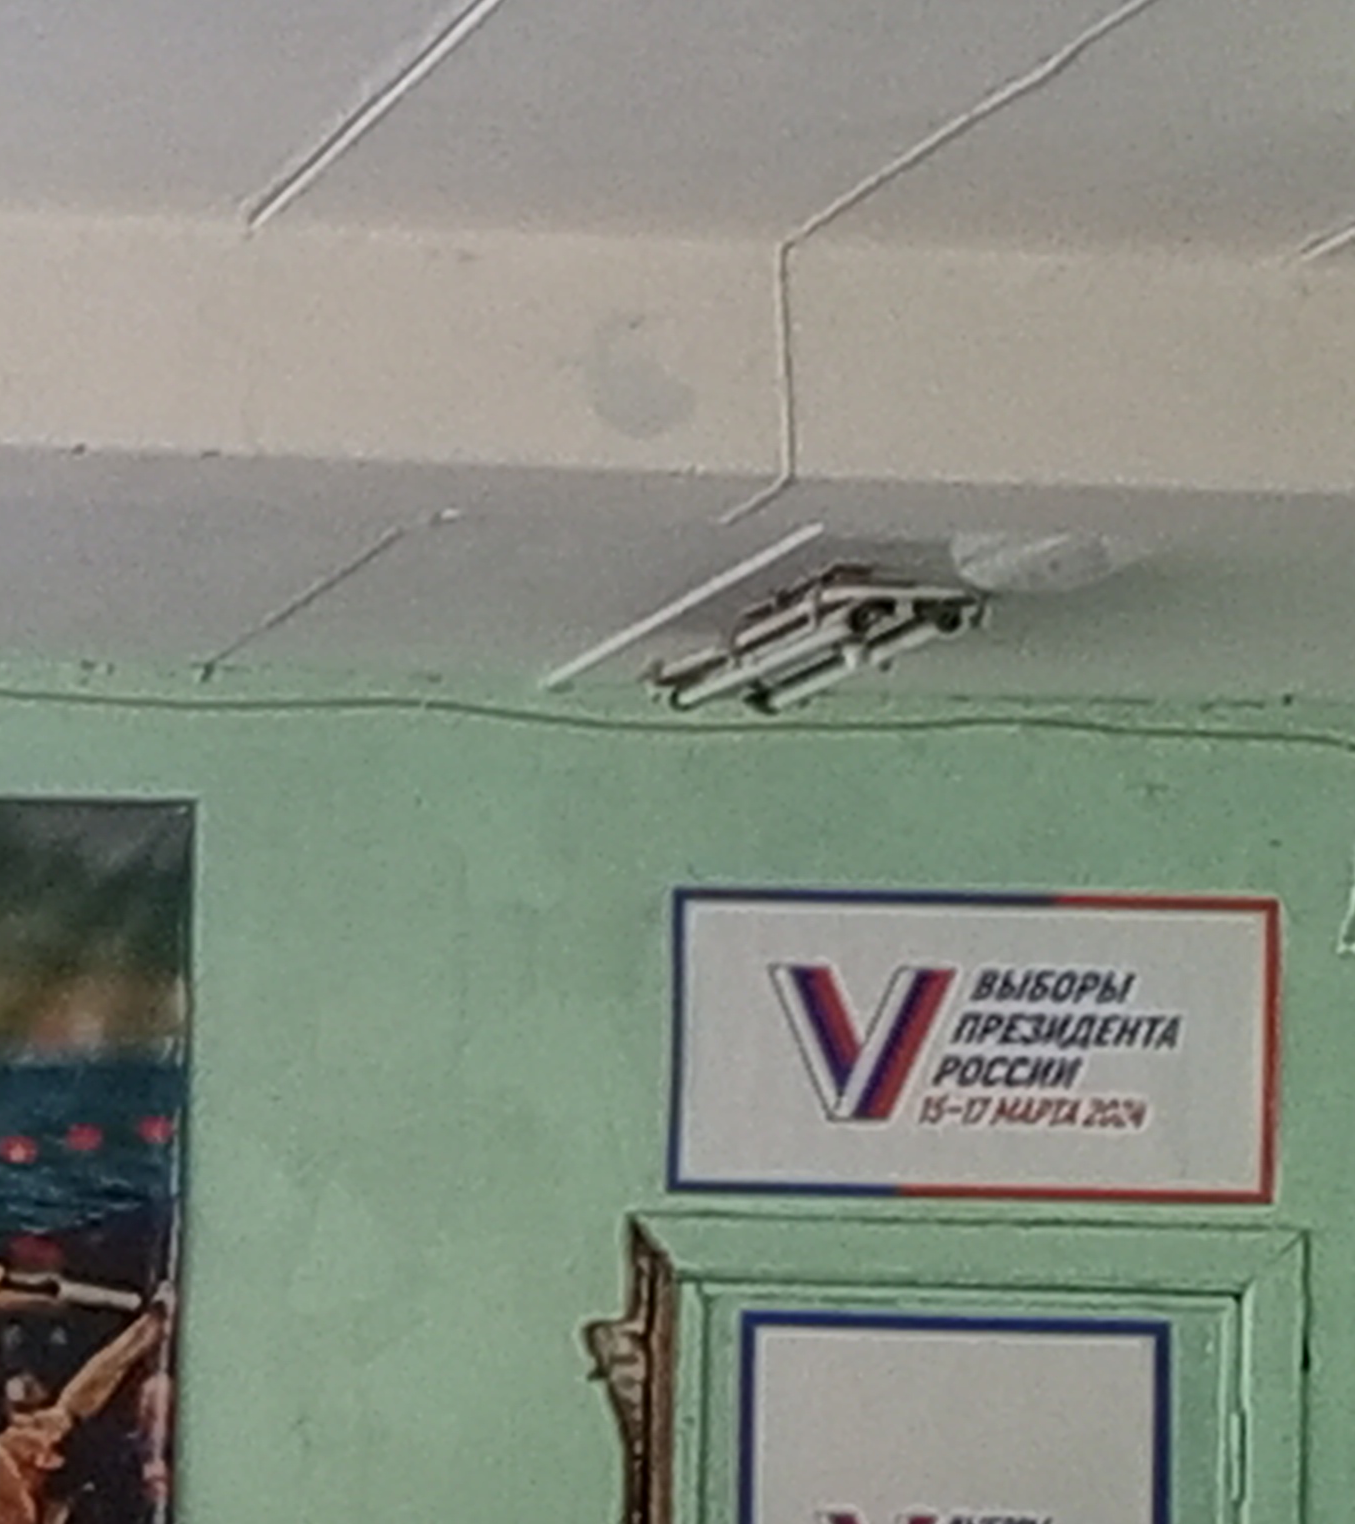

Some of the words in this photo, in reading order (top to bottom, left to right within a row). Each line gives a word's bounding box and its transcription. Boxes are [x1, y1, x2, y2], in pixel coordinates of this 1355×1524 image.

[969, 968, 1137, 1004] ВЫБОРЫ
[949, 1011, 1182, 1051] ПРЕЗИДЕНТА
[931, 1054, 1083, 1090] РОССИИ
[989, 1096, 1081, 1128] МАРТА
